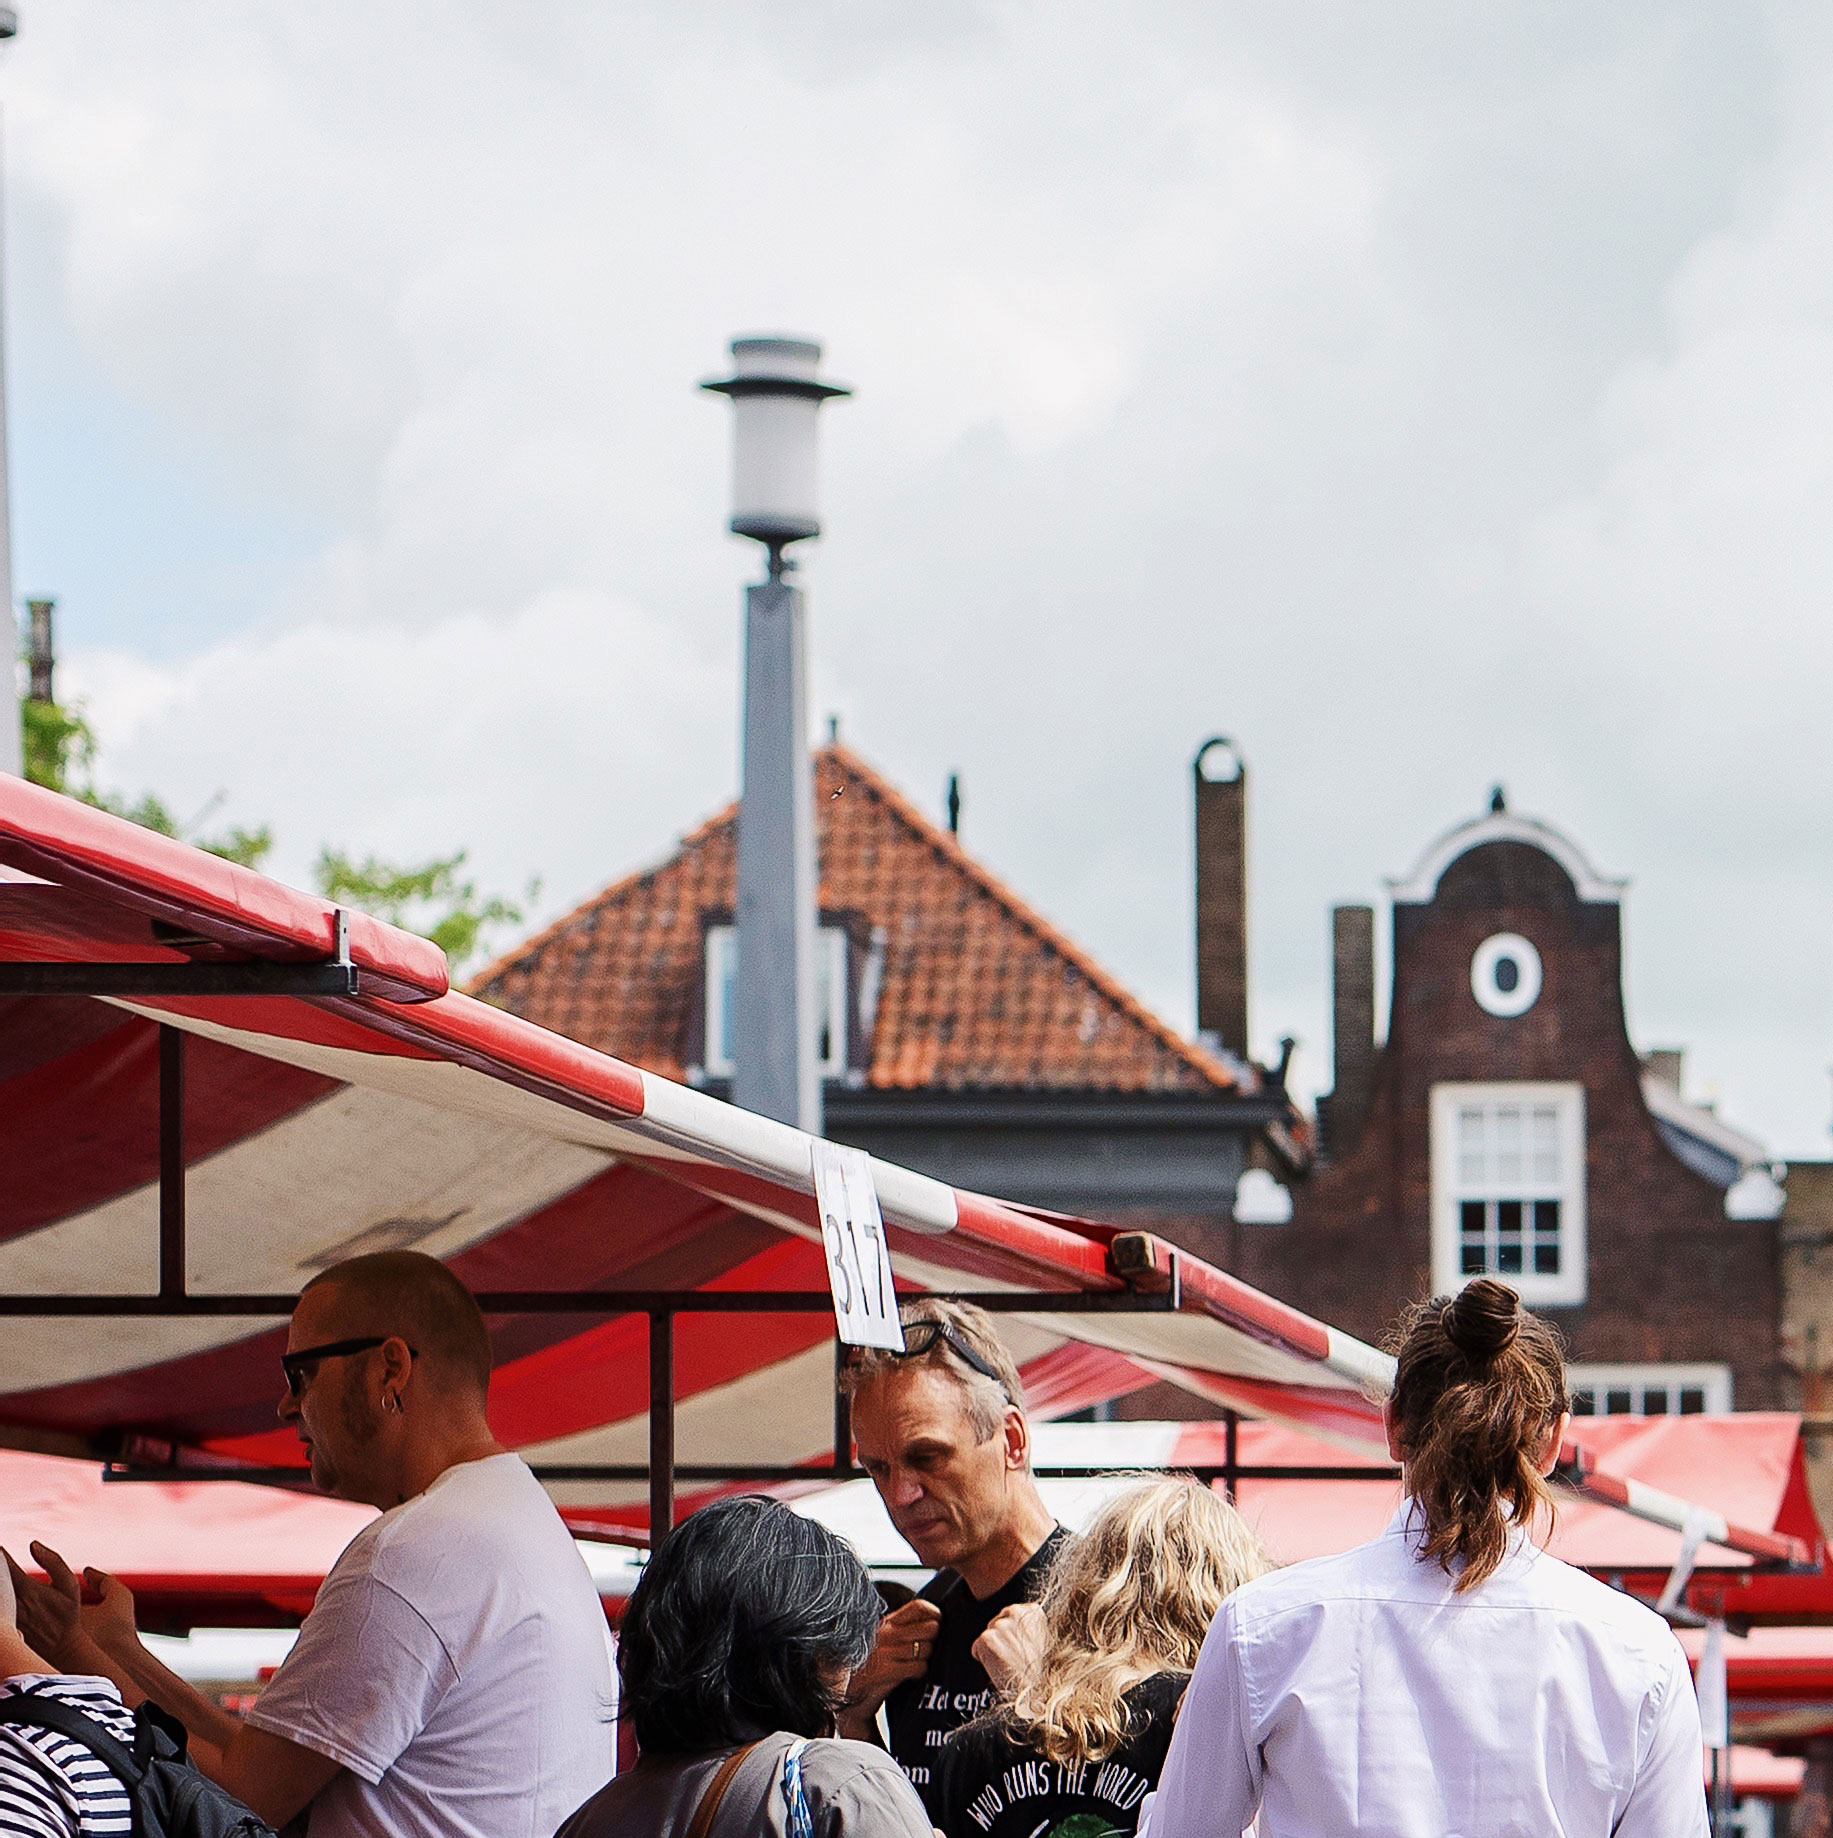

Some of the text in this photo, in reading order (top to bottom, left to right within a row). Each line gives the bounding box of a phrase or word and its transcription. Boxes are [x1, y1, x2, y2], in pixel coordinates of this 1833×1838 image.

[826, 1213, 885, 1319] 317
[967, 1758, 1149, 1832] WHO RUNS THE WORLD
